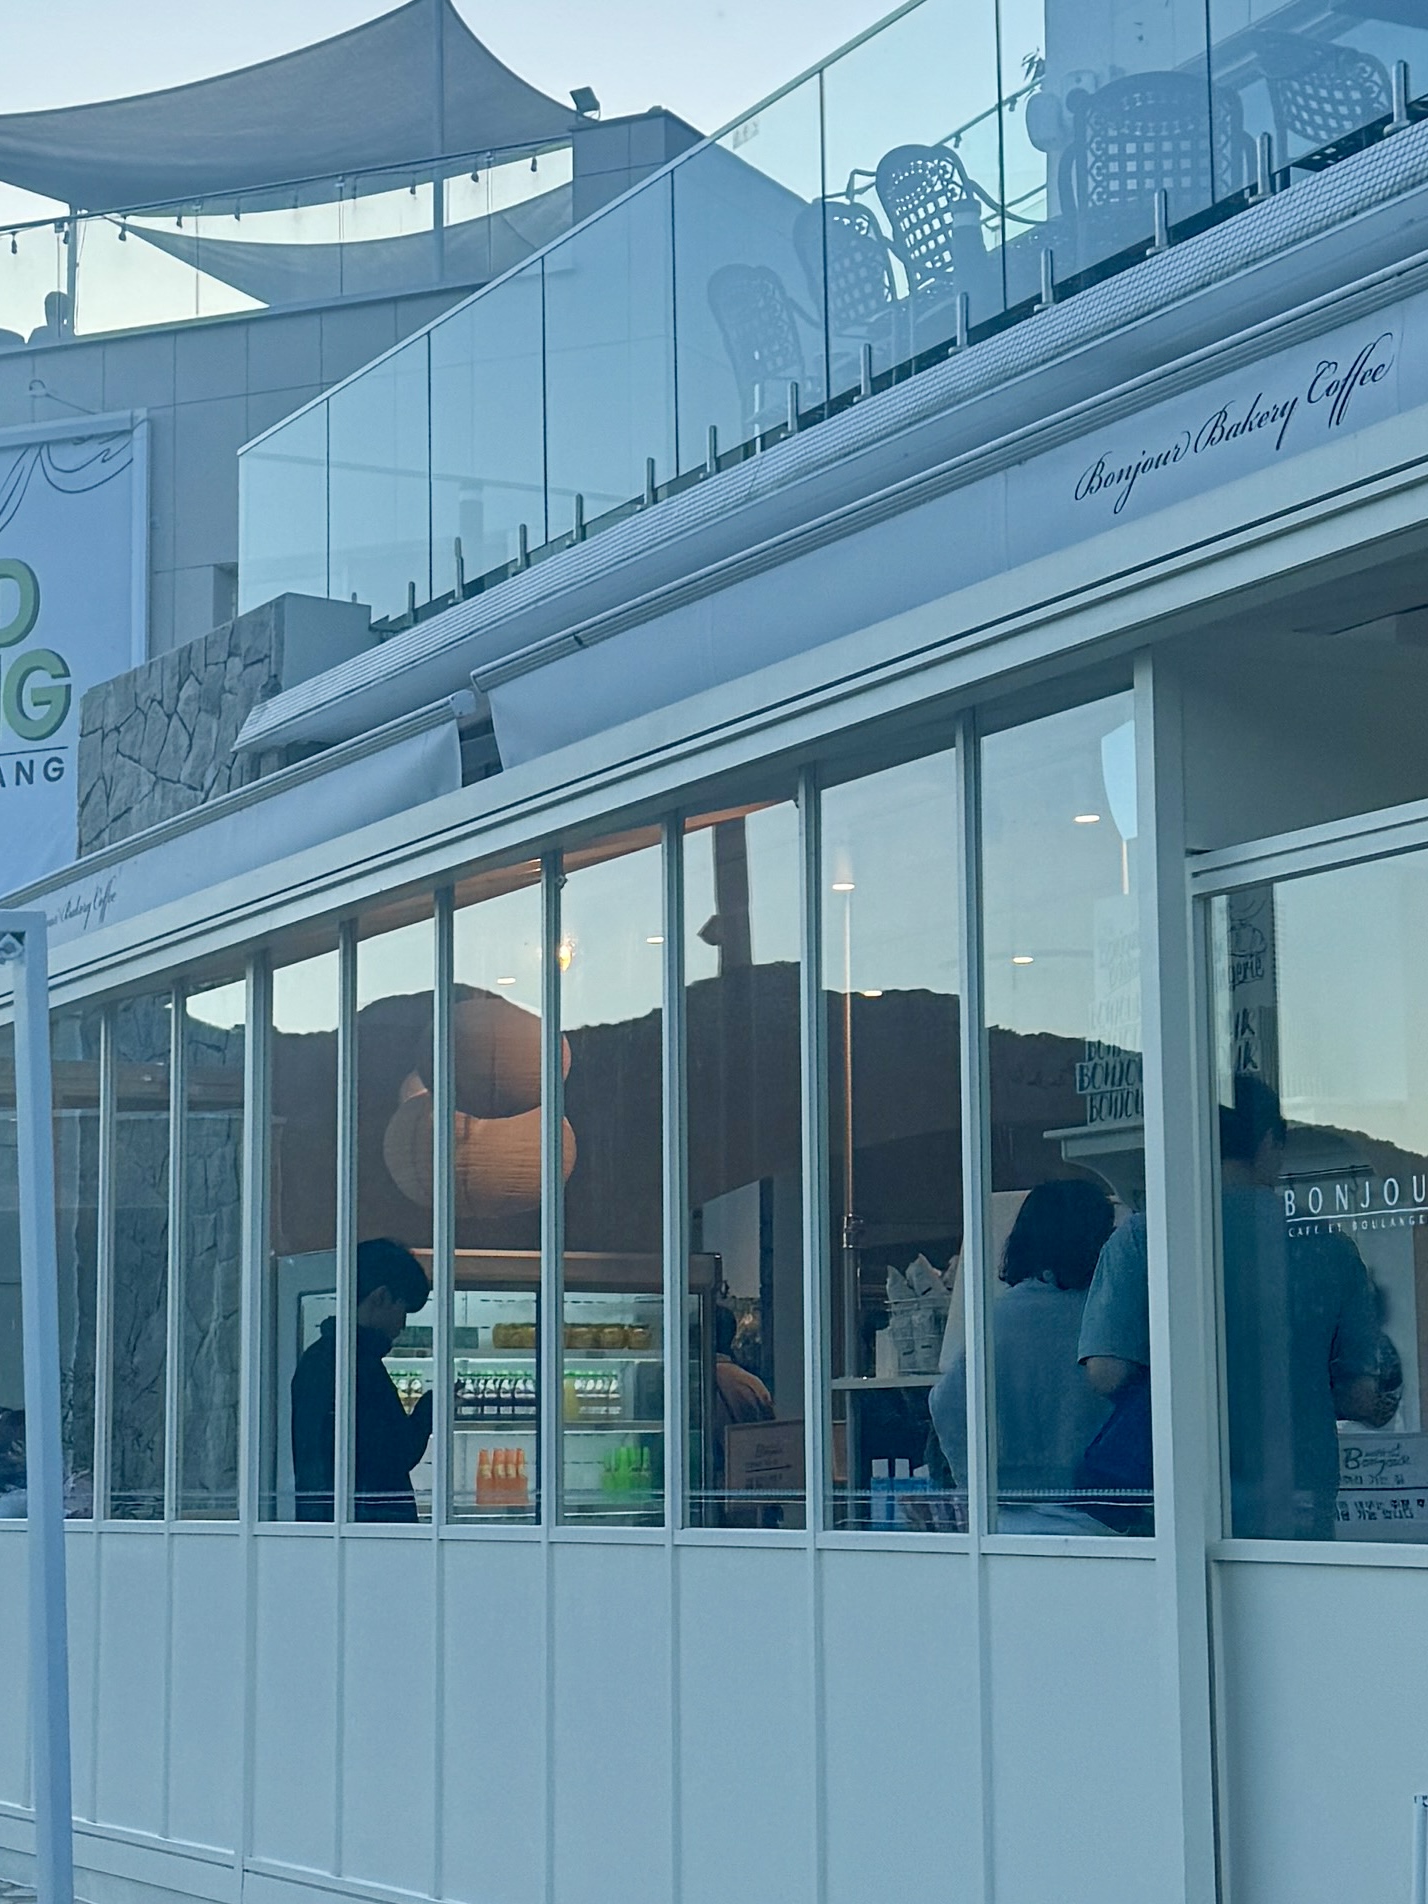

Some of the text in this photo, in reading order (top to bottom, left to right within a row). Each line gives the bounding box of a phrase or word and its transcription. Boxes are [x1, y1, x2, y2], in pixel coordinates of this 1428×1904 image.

[1074, 332, 1396, 515] Bonjour Bakery Coffee
[1079, 1057, 1141, 1092] BONJO
